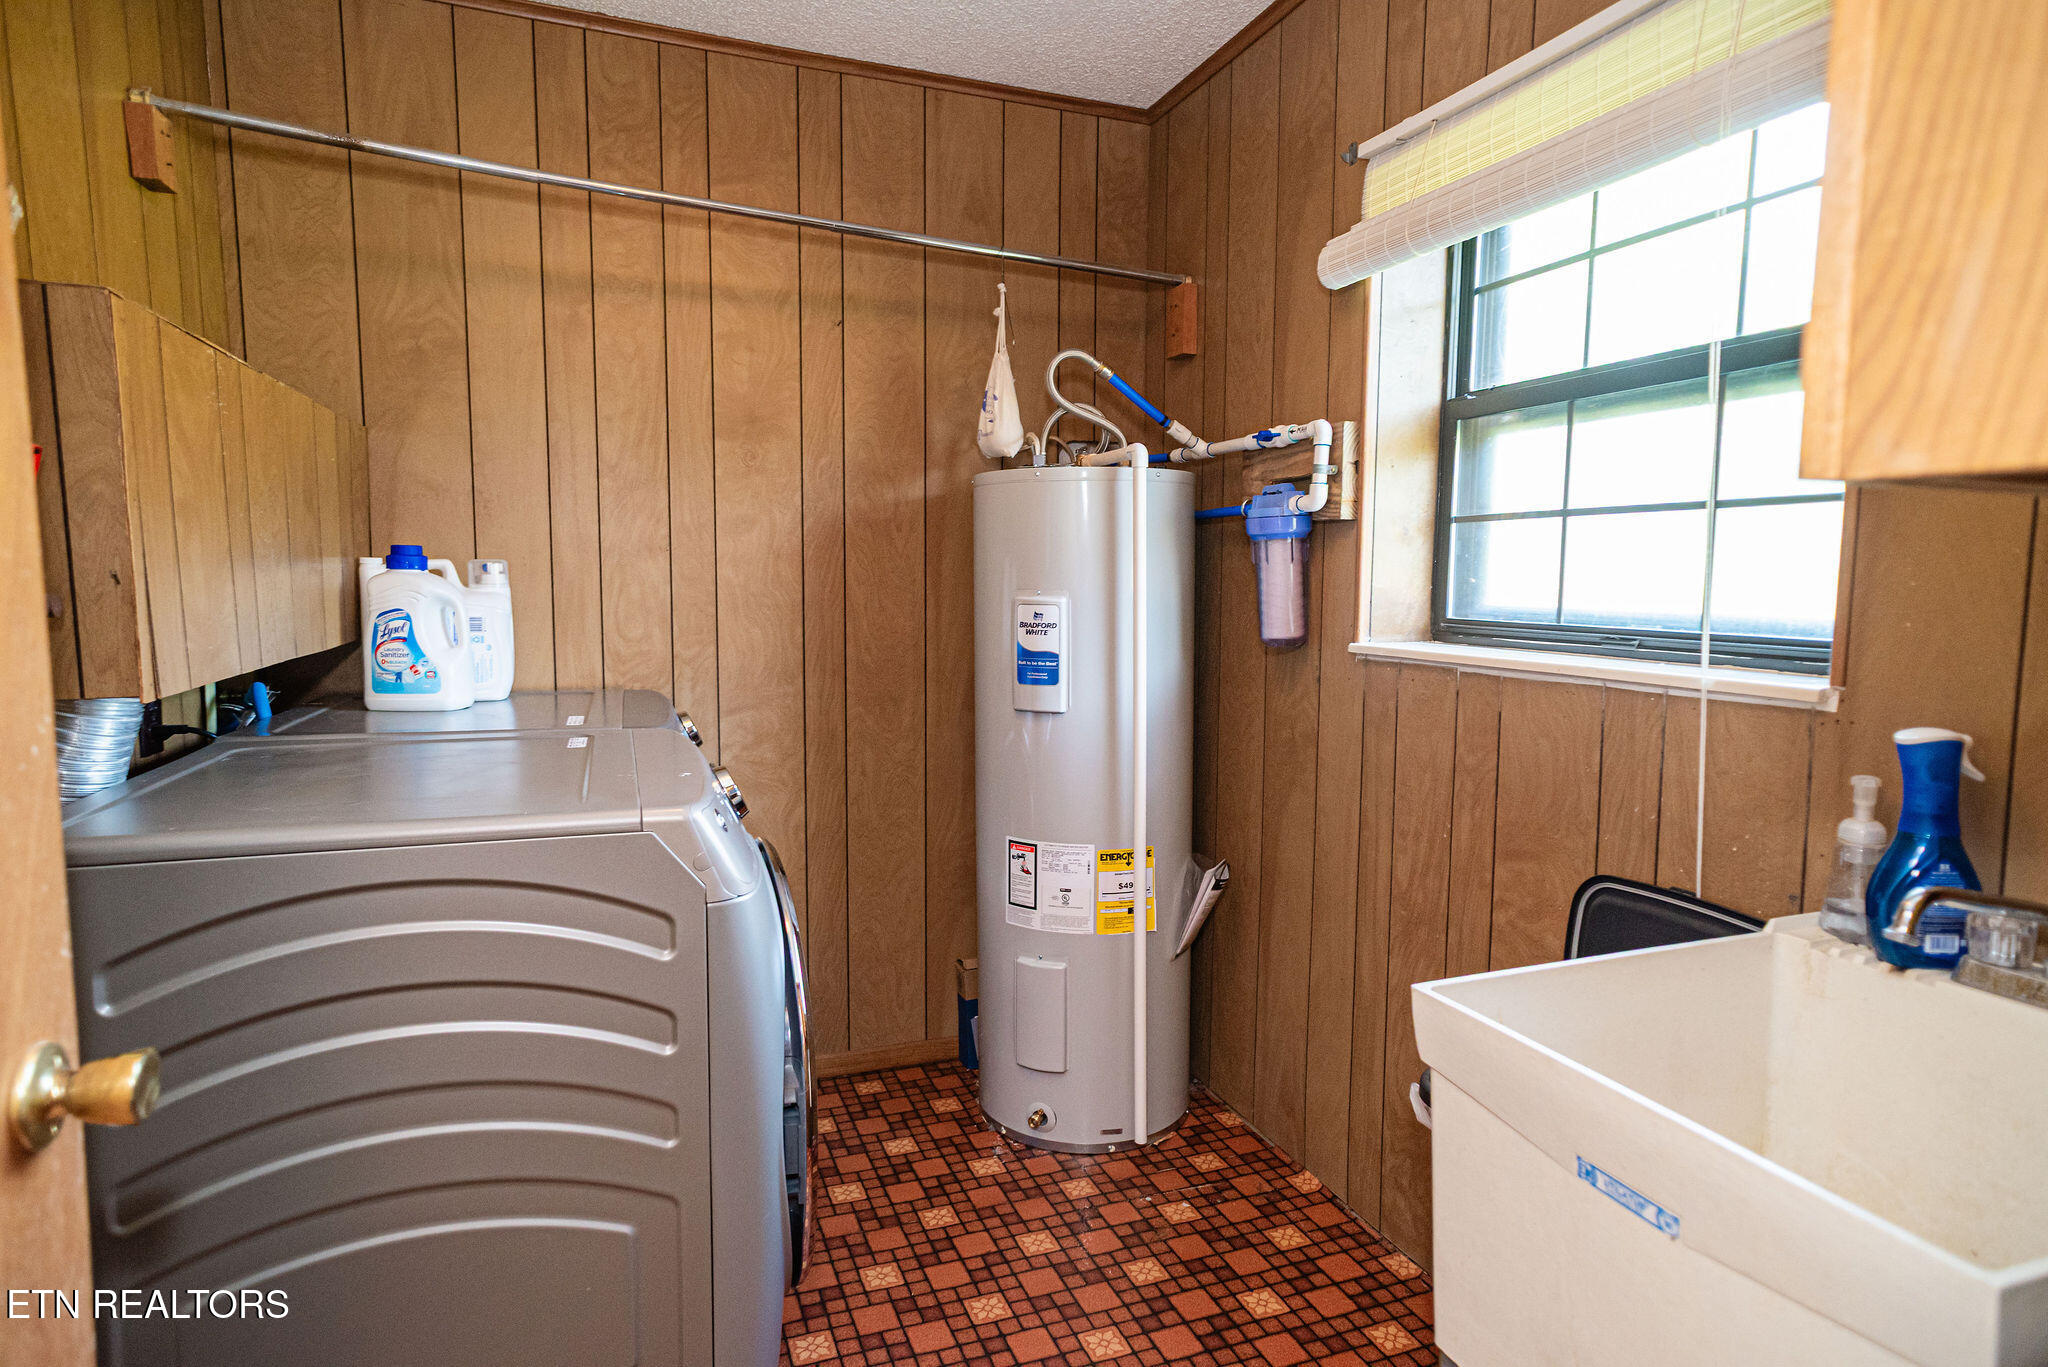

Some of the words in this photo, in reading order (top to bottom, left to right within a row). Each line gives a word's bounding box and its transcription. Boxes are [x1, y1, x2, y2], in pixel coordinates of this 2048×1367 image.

[1019, 621, 1058, 629] BRADFORD
[380, 622, 407, 640] Lysol
[1025, 628, 1048, 636] WHITE
